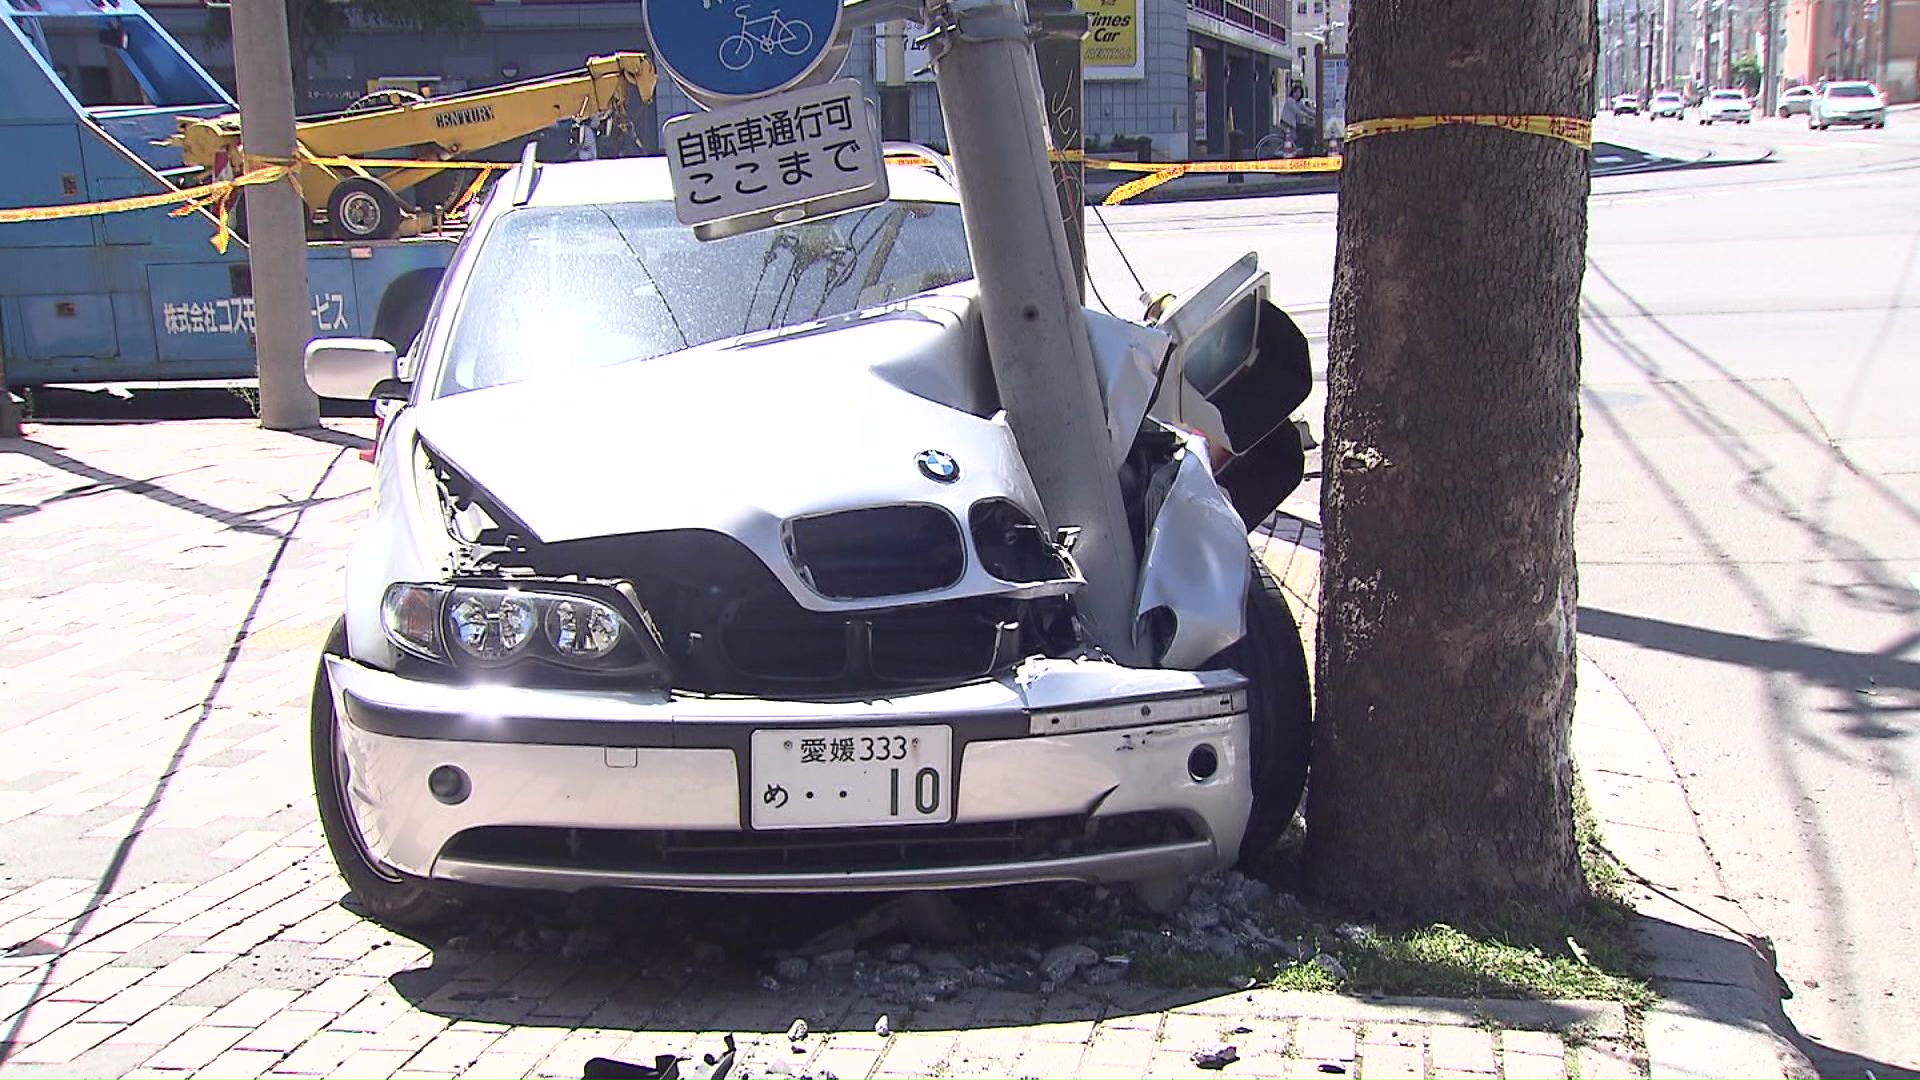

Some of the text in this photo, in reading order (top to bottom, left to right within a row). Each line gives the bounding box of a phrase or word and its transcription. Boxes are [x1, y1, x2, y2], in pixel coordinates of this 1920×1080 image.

[1094, 27, 1120, 42] Car
[432, 105, 495, 128] CENTURY
[677, 96, 852, 168] 自転車通行可
[689, 140, 861, 204] ここまで
